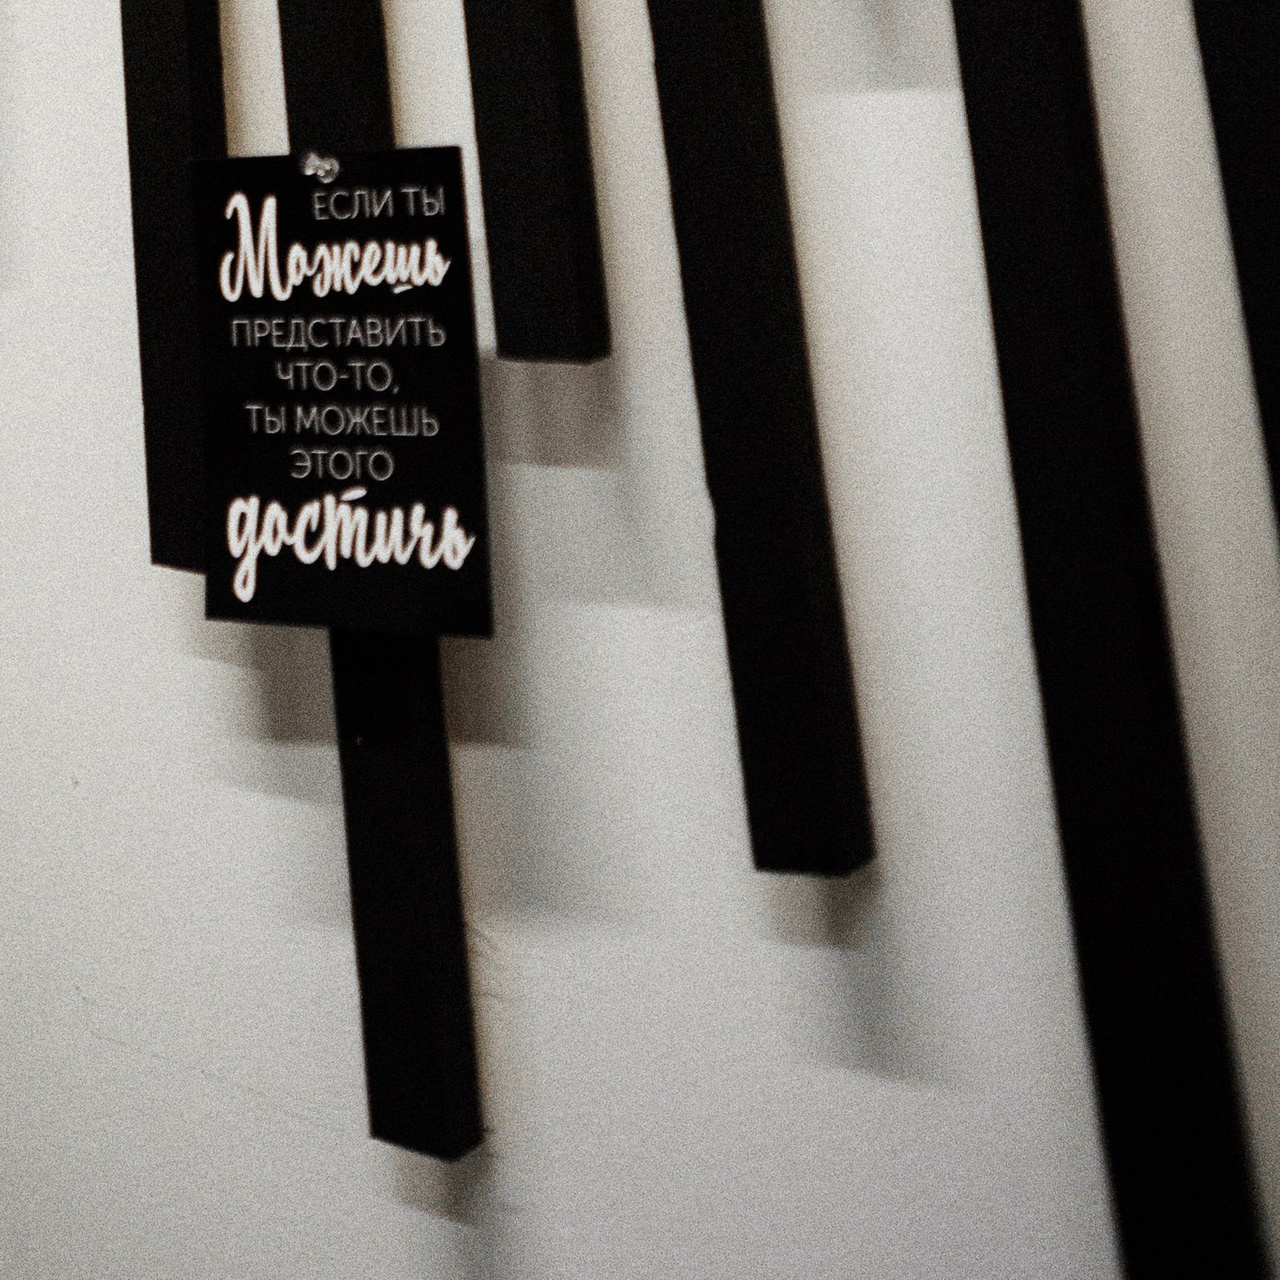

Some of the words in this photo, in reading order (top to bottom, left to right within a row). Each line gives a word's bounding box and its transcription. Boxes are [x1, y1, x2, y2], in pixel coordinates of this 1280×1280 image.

[313, 188, 394, 221] ЕСЛИ
[400, 186, 445, 217] ТЫ
[220, 192, 451, 303] Можешь
[231, 316, 446, 351] ПРЕДСТАВИТЬ
[276, 360, 399, 394] ЧТО-ТО,
[244, 403, 287, 435] ТЫ
[295, 404, 440, 437] МОЖЕШЬ
[290, 447, 395, 482] ЭТОГО
[227, 487, 475, 603] достичь
